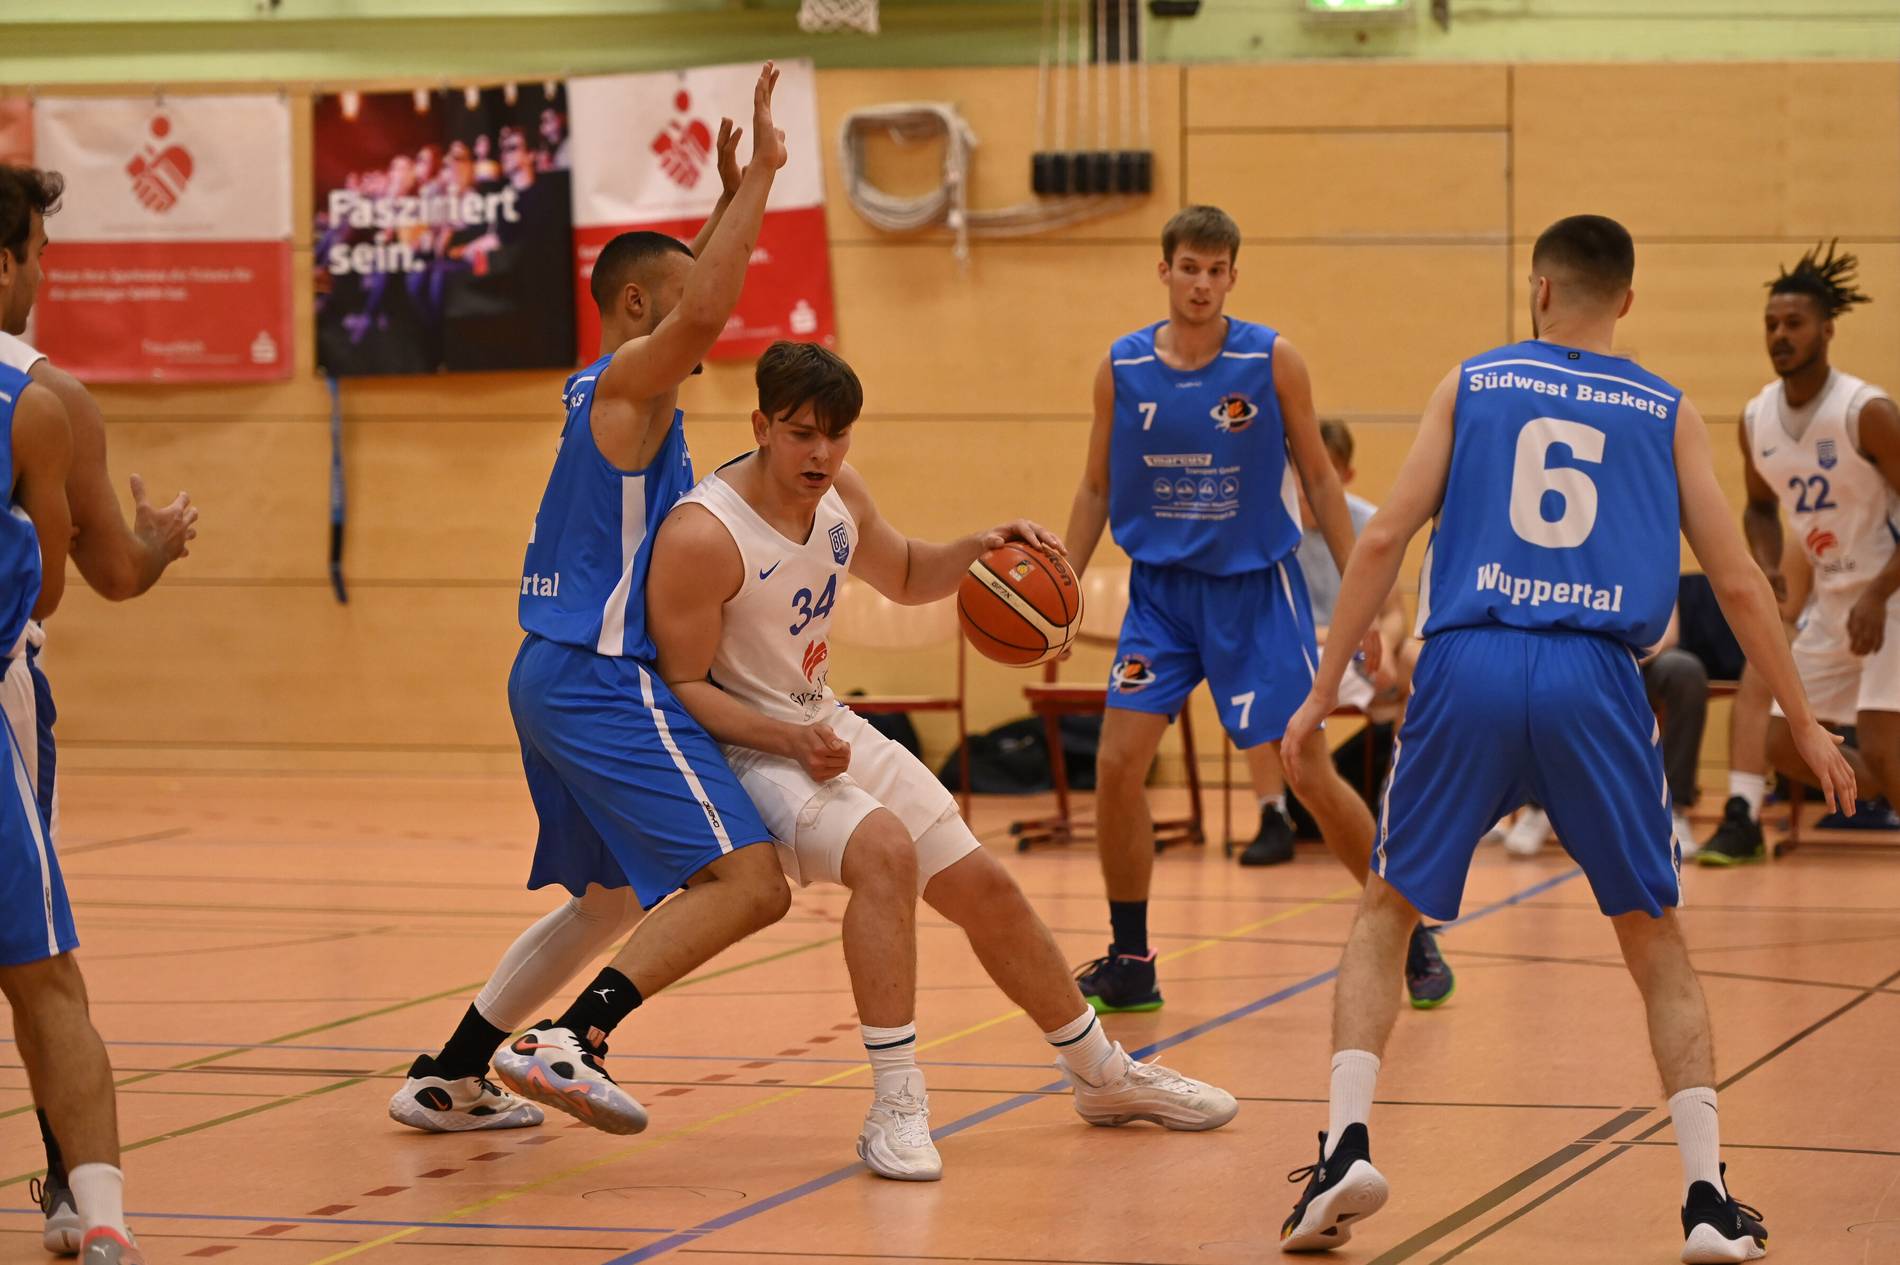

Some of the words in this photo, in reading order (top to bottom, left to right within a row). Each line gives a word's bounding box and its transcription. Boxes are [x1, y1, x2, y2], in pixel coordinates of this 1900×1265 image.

[328, 231, 426, 275] sein.
[1138, 402, 1157, 430] 7
[1469, 372, 1568, 398] Südwest
[1576, 384, 1668, 419] Baskets
[1509, 416, 1606, 549] 6
[1788, 474, 1837, 514] 22
[521, 572, 559, 597] rtal
[789, 573, 837, 636] 34
[1476, 562, 1623, 613] Wuppertal
[1230, 691, 1255, 730] 7
